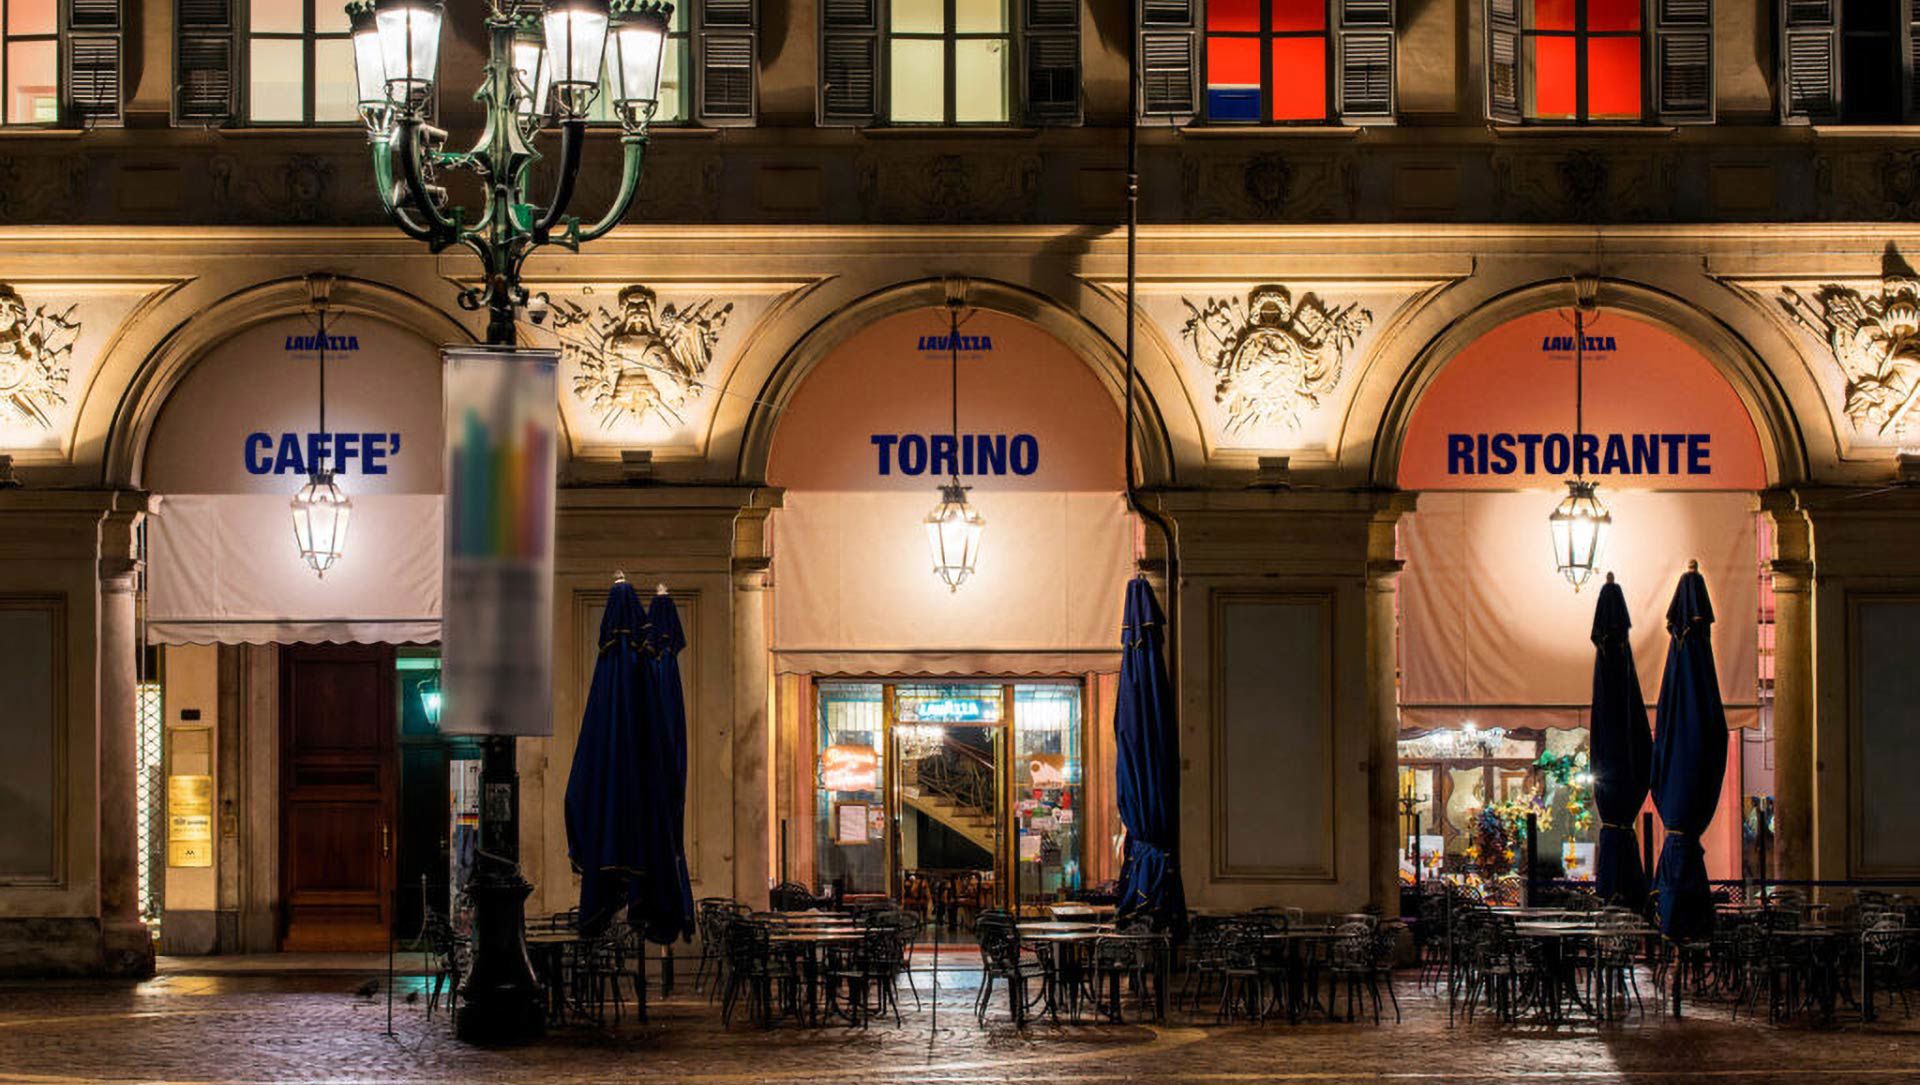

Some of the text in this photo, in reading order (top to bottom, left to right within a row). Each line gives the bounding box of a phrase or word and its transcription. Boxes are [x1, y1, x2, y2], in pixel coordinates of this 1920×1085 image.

[285, 330, 360, 350] LAVAZZA
[918, 331, 992, 350] LAVAZZA
[1543, 332, 1617, 351] LAVAZZA
[244, 432, 401, 476] CAFFE'
[871, 434, 1039, 476] TORINO
[1448, 433, 1711, 475] RISTORANTE
